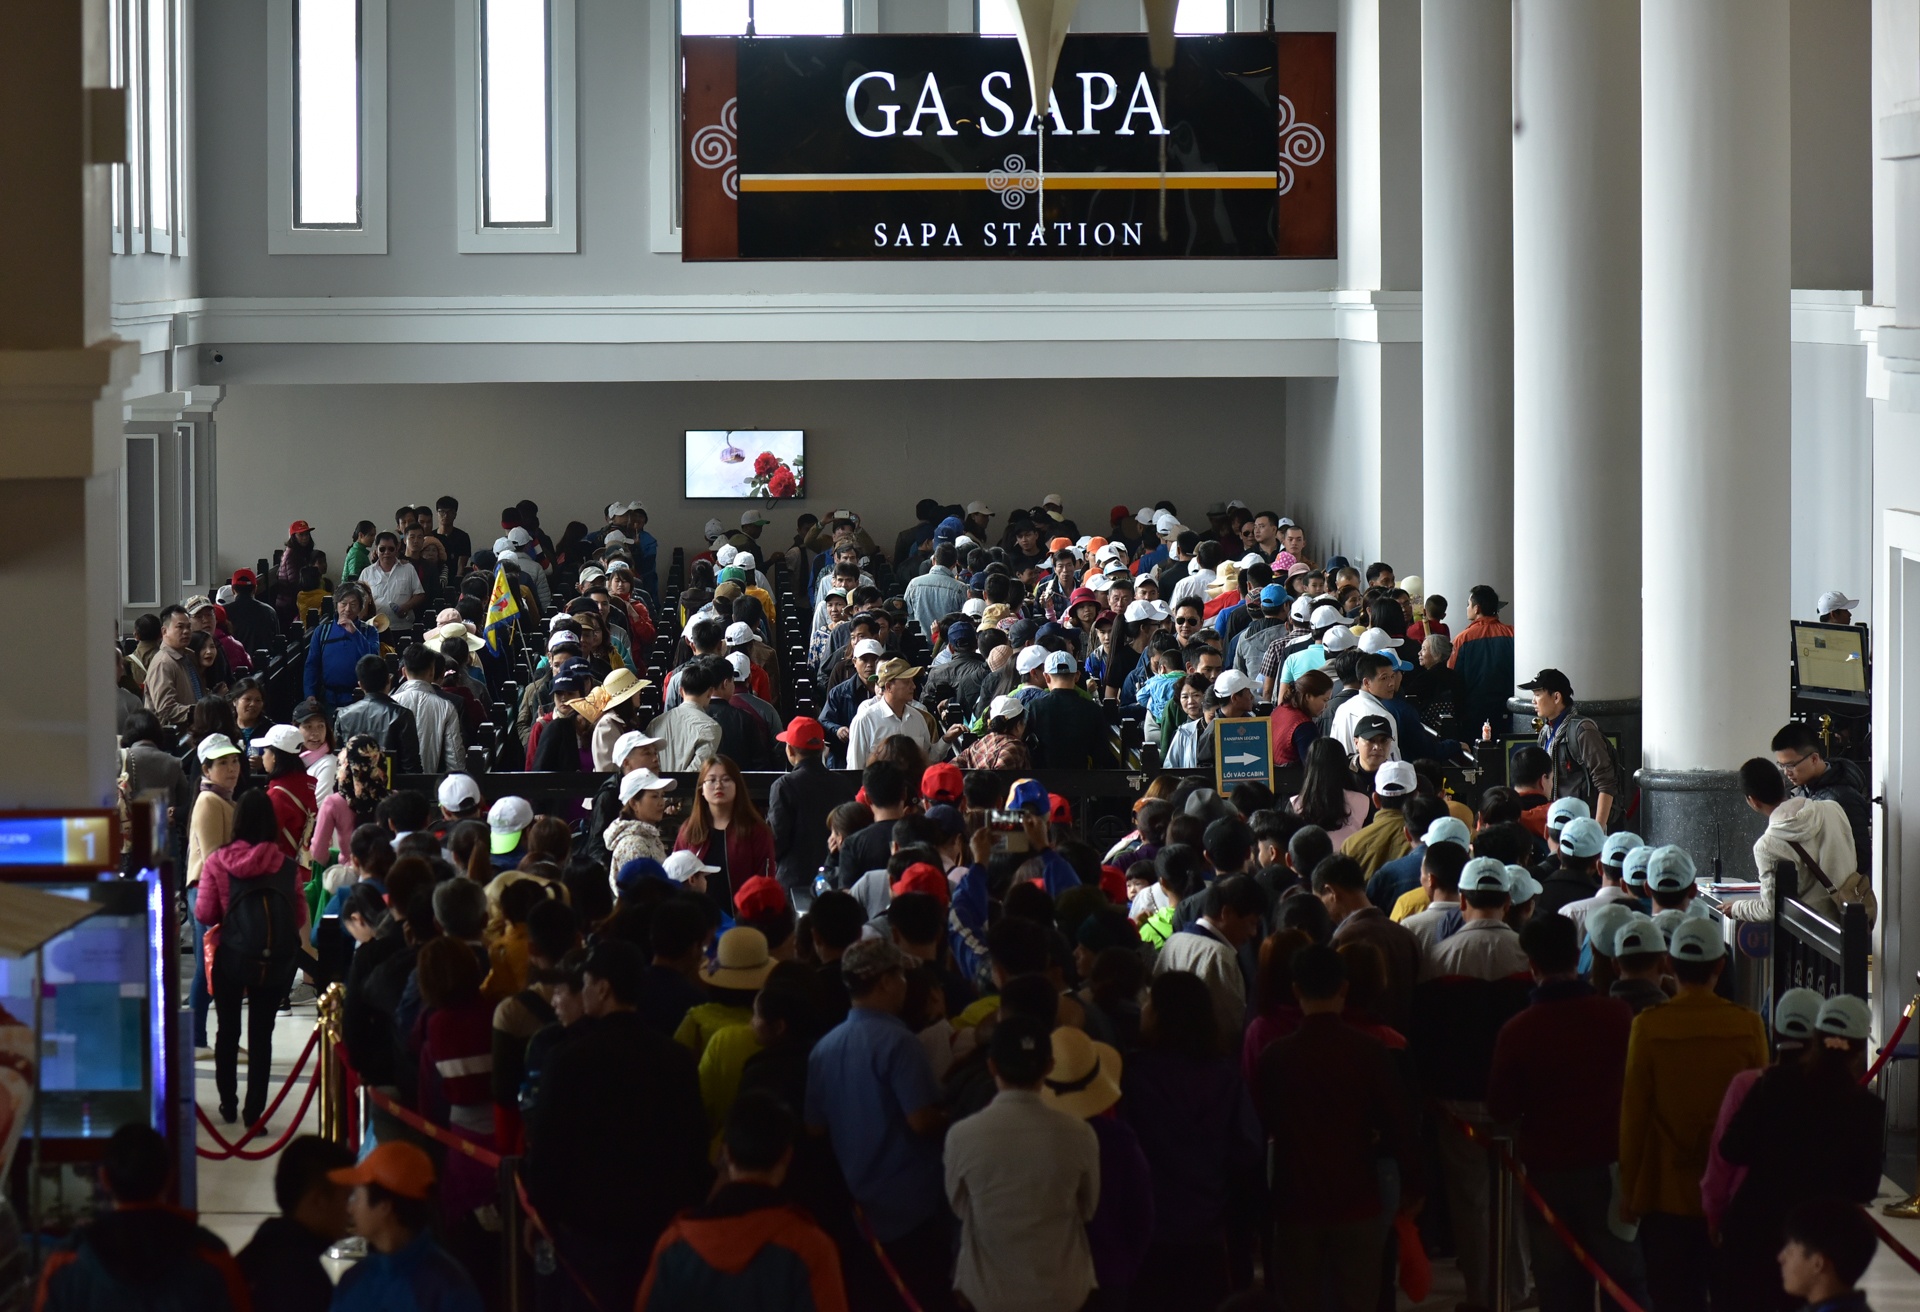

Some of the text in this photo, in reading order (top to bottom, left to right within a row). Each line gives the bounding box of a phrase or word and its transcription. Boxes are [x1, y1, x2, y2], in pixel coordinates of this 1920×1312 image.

[845, 71, 1170, 138] GA SAPA
[874, 222, 1143, 248] SAPA STATION
[82, 832, 95, 861] 1
